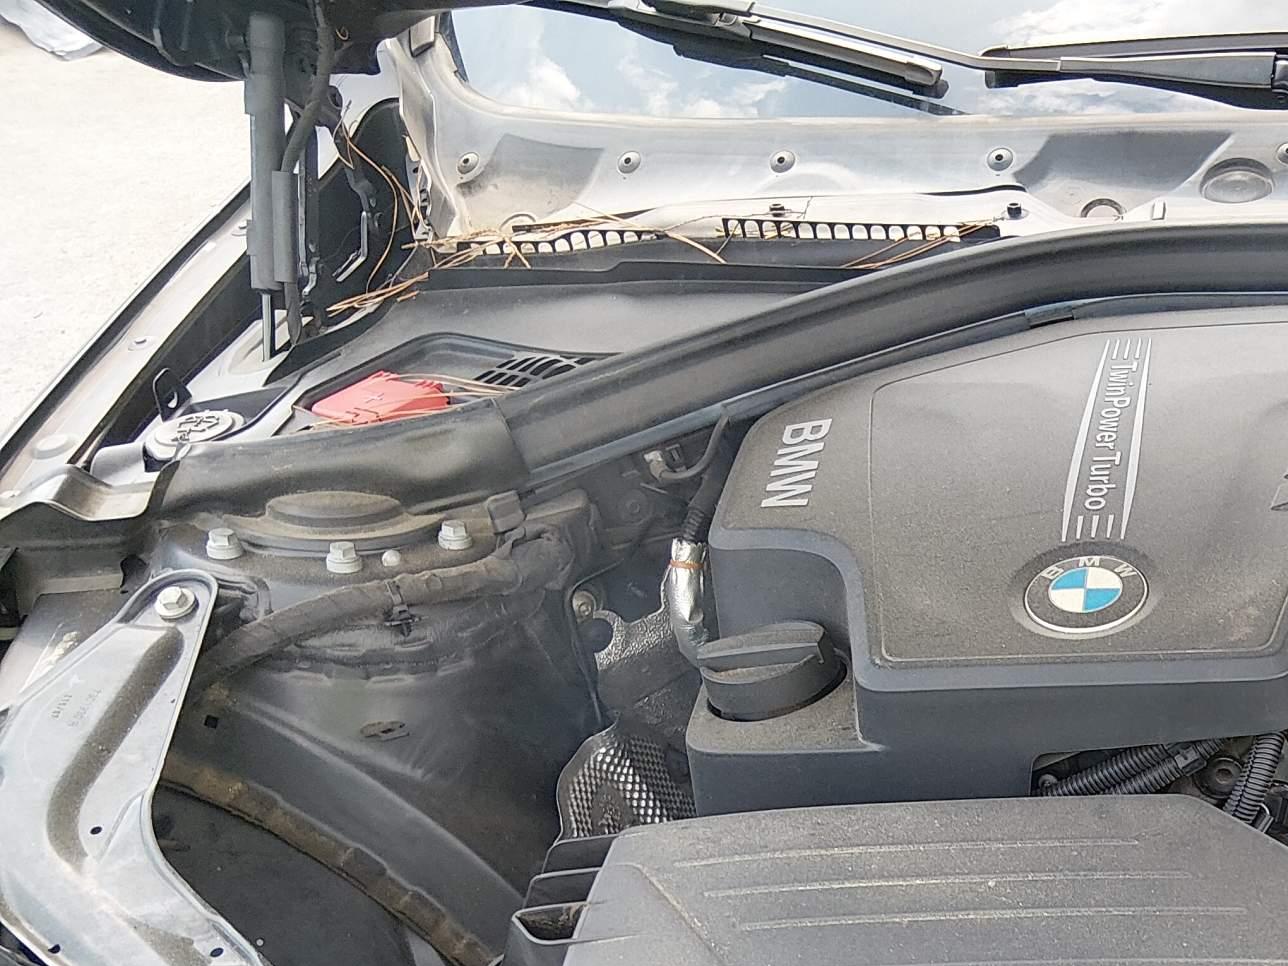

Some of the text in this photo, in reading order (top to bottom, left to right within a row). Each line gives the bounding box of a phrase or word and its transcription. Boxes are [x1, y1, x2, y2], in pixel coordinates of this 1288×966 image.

[761, 417, 832, 508] BMW
[1084, 361, 1138, 511] TwinPower Turbo
[1043, 557, 1137, 580] BMW
